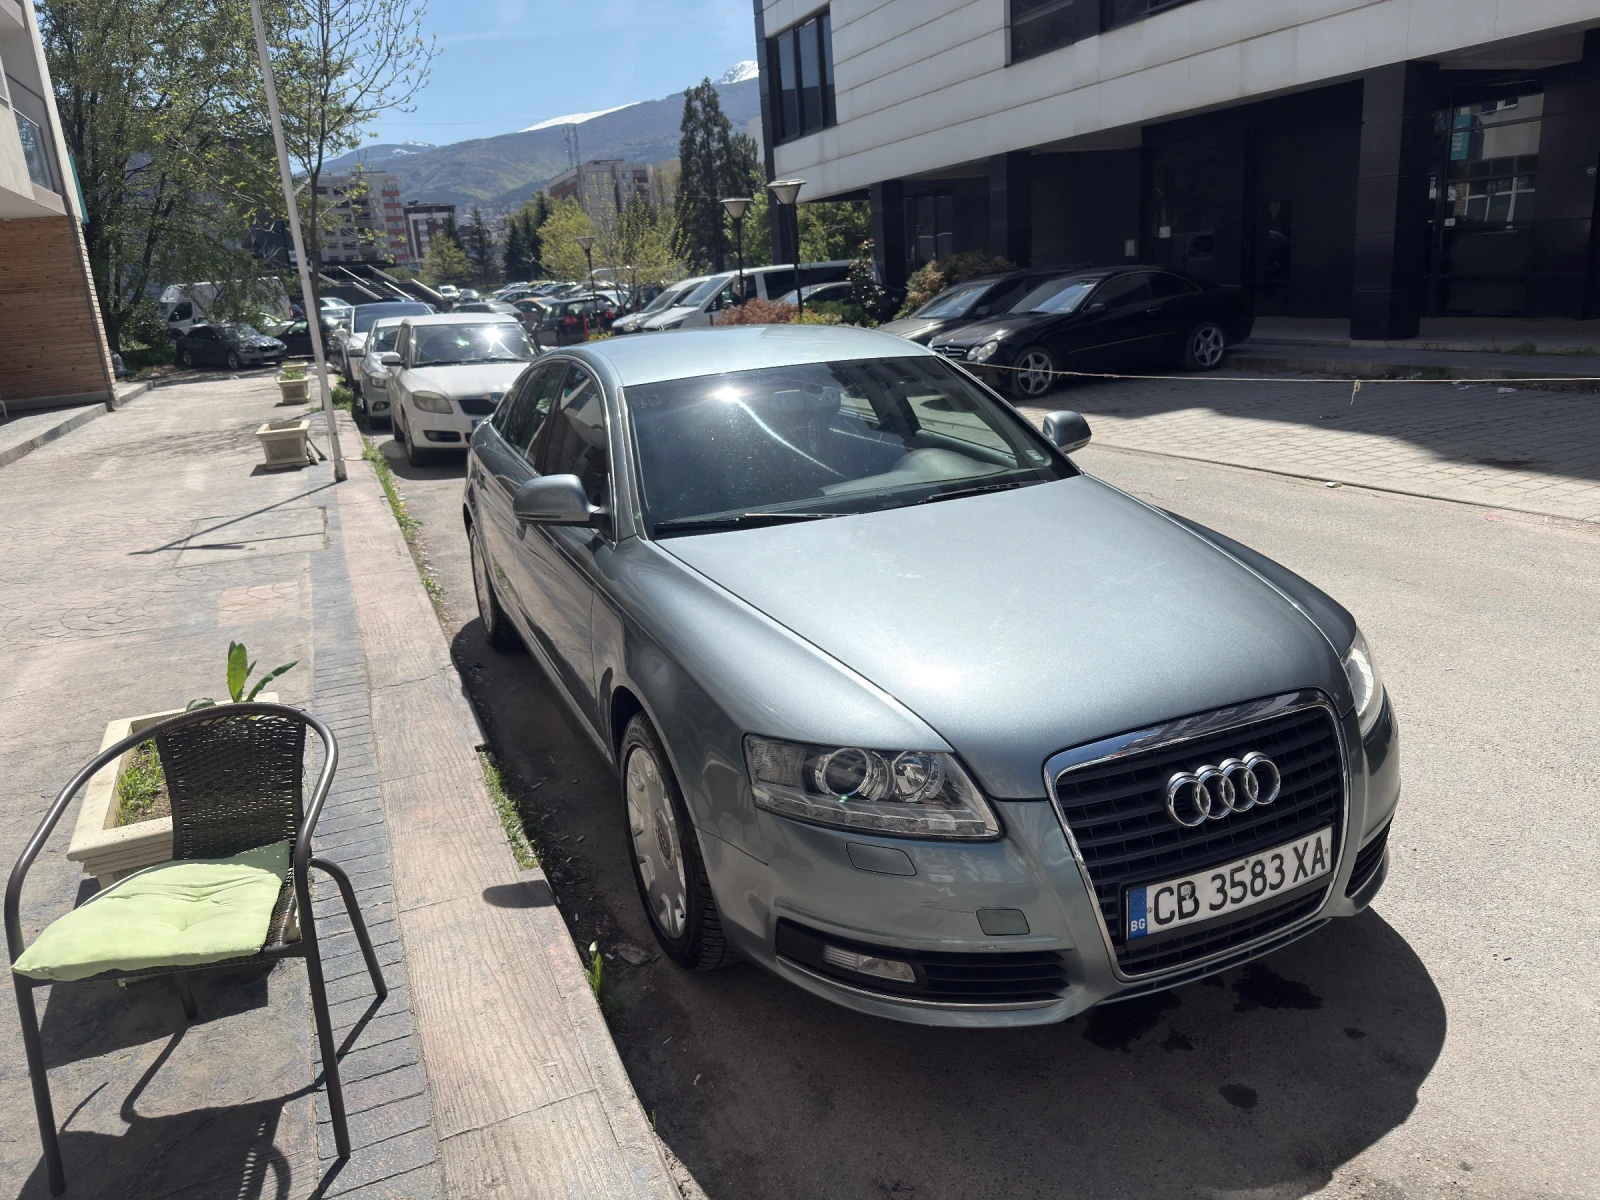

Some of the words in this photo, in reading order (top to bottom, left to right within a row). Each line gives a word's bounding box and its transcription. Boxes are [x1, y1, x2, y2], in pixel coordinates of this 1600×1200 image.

[1153, 880, 1200, 926] CB
[1209, 853, 1286, 911] 3583
[1292, 836, 1327, 884] XA
[1130, 918, 1146, 932] BG
